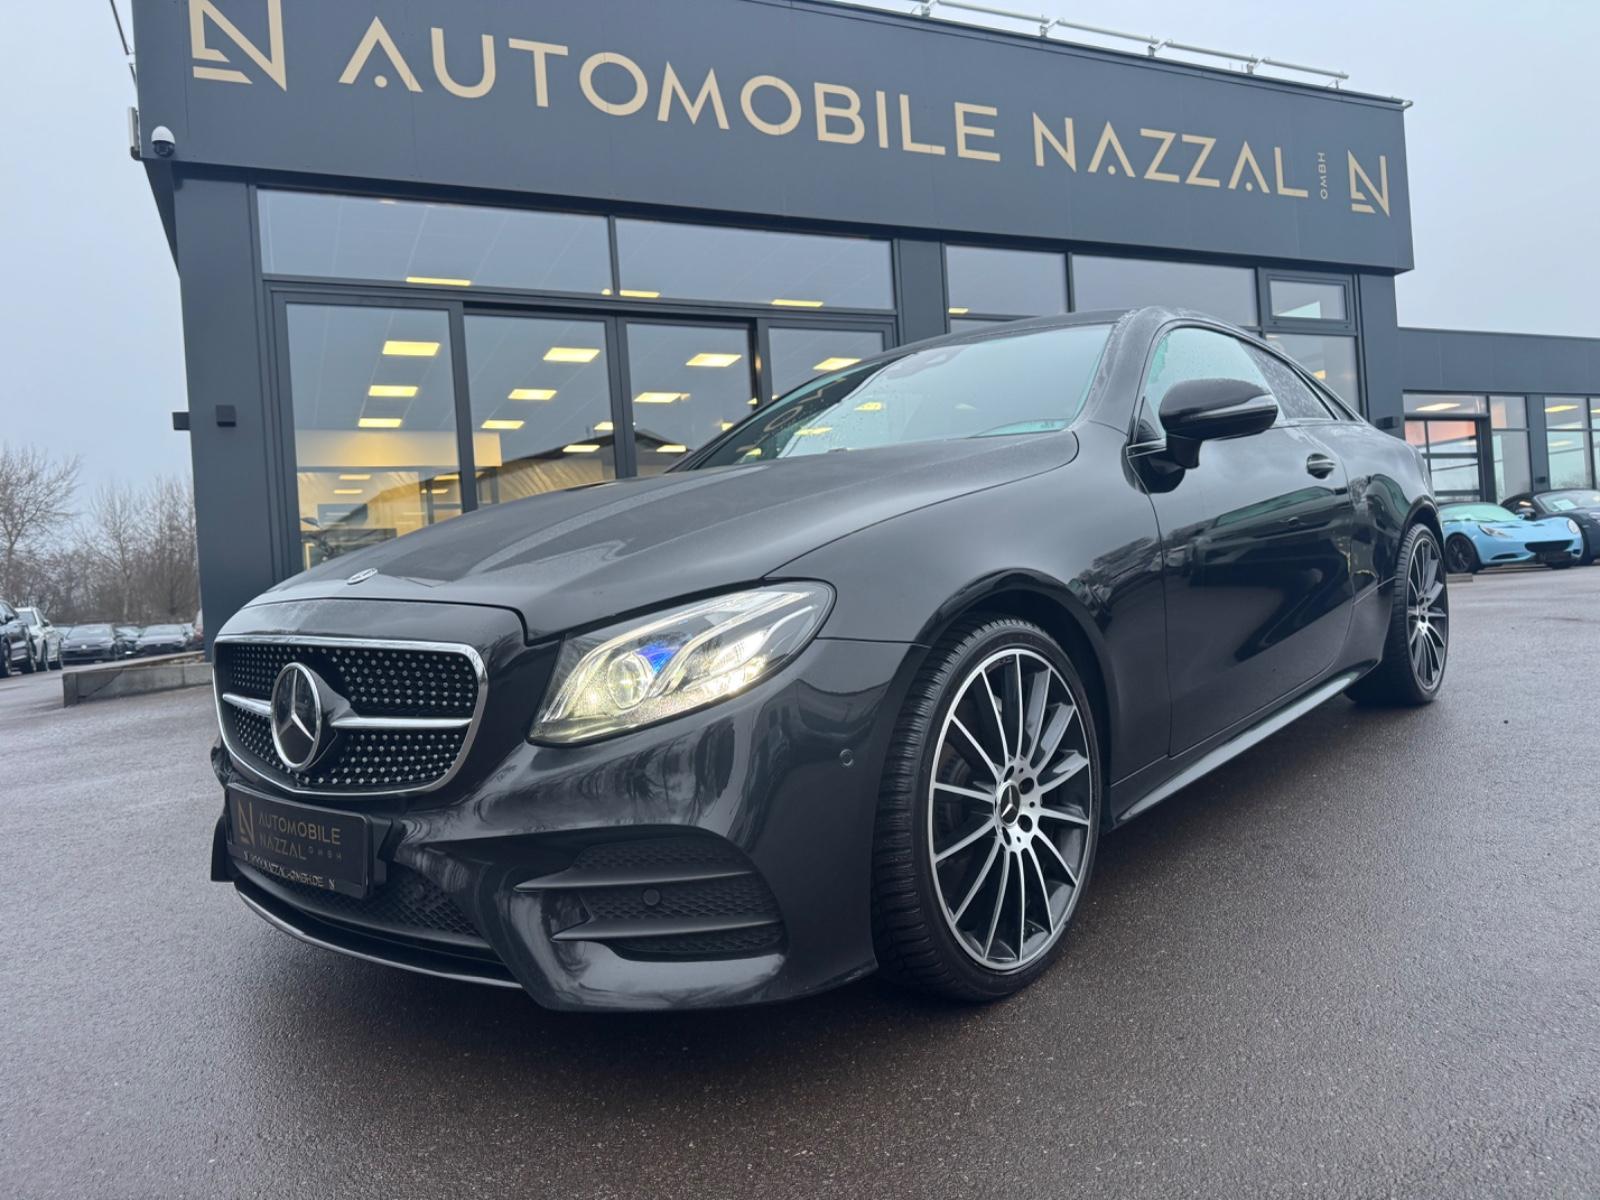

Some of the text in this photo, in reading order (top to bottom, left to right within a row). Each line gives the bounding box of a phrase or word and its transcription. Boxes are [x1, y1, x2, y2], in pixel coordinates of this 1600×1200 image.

[339, 16, 1001, 163] AUTOMOBILE
[1032, 112, 1309, 199] NAZZAL
[259, 813, 341, 845] AUTOMOBILE
[259, 835, 307, 860] NAZZAL
